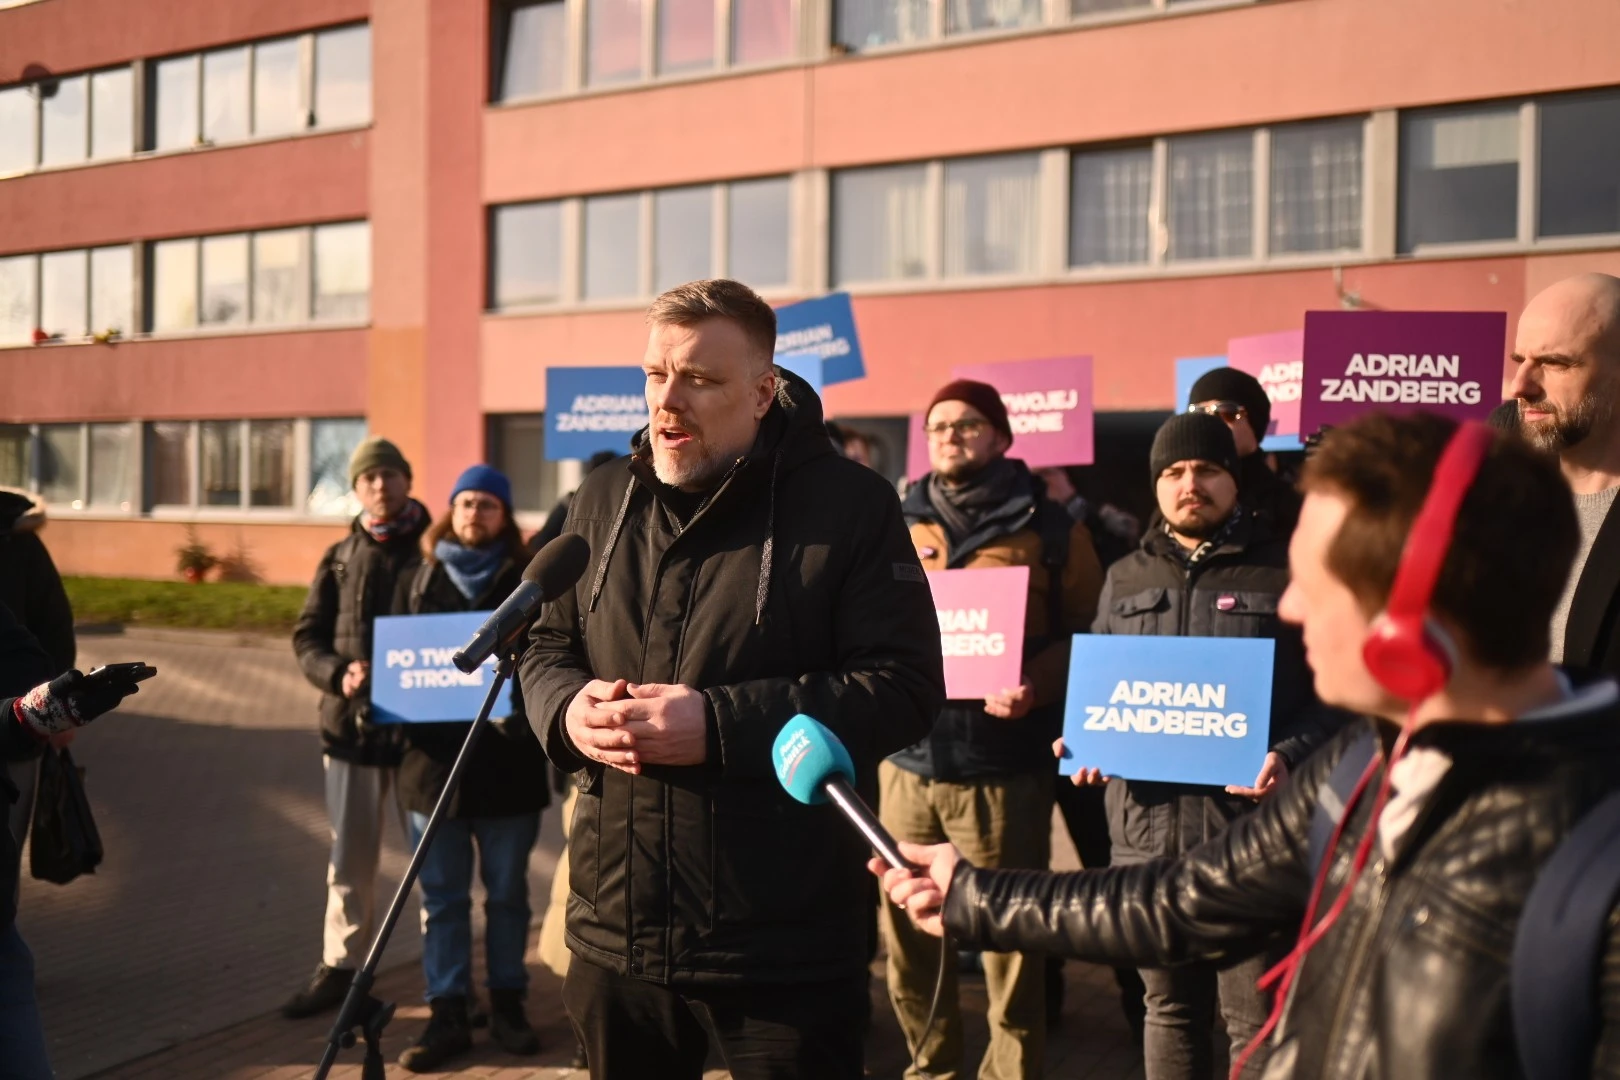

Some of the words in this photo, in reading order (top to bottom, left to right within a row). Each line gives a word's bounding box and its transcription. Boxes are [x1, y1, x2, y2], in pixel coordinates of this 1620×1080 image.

[1257, 360, 1303, 385] ADR
[1344, 353, 1460, 378] ADRIAN
[1320, 378, 1482, 405] ZANDBERG
[940, 631, 1006, 657] BERG
[386, 648, 416, 669] PO
[1109, 680, 1226, 709] ADRIAN
[1083, 706, 1248, 738] ZANDBERG
